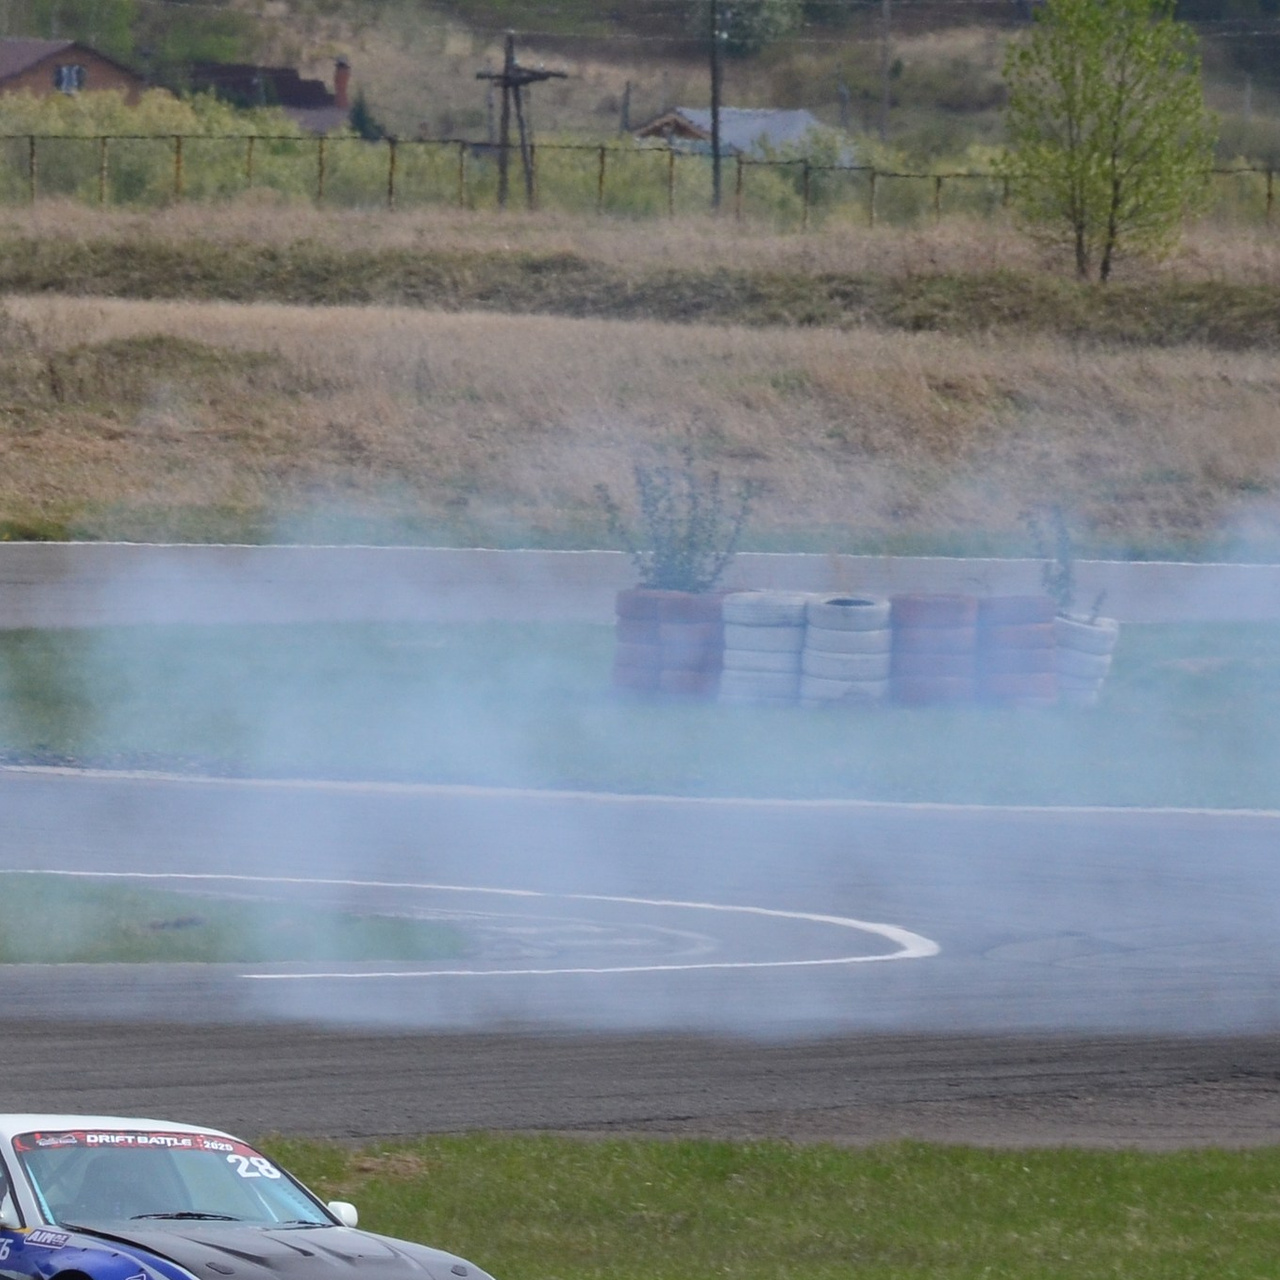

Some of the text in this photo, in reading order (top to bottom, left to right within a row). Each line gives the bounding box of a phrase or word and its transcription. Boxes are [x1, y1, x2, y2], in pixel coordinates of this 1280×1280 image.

[86, 1134, 135, 1144] DRIFT
[137, 1136, 193, 1148] BATTLE
[226, 1153, 281, 1180] 28
[28, 1229, 66, 1246] AIMOL
